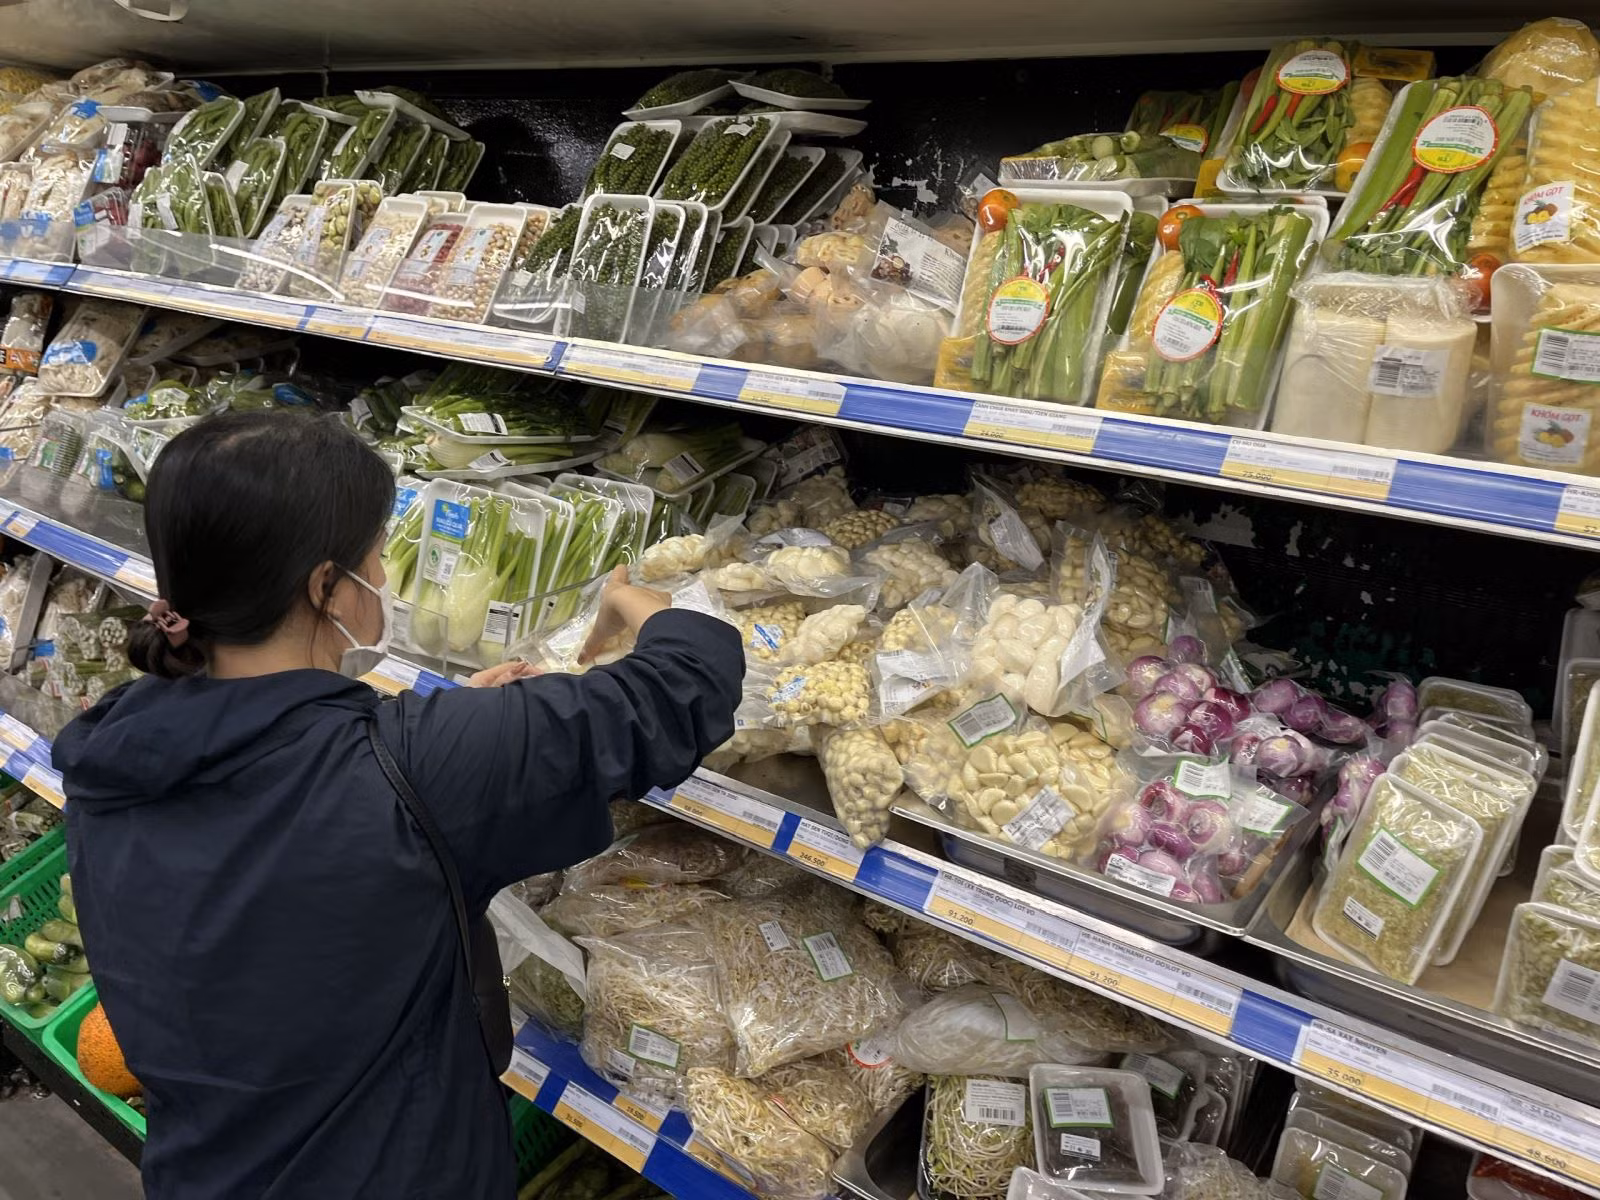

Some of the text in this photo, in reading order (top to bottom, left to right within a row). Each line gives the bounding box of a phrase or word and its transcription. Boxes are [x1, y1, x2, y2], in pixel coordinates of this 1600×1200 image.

[799, 851, 826, 867] 246.500
[975, 887, 995, 900] TRUNG
[994, 895, 1014, 909] QUOC)
[1014, 902, 1026, 912] LOT
[947, 909, 975, 926] 91.200
[1089, 970, 1119, 987] 91.200
